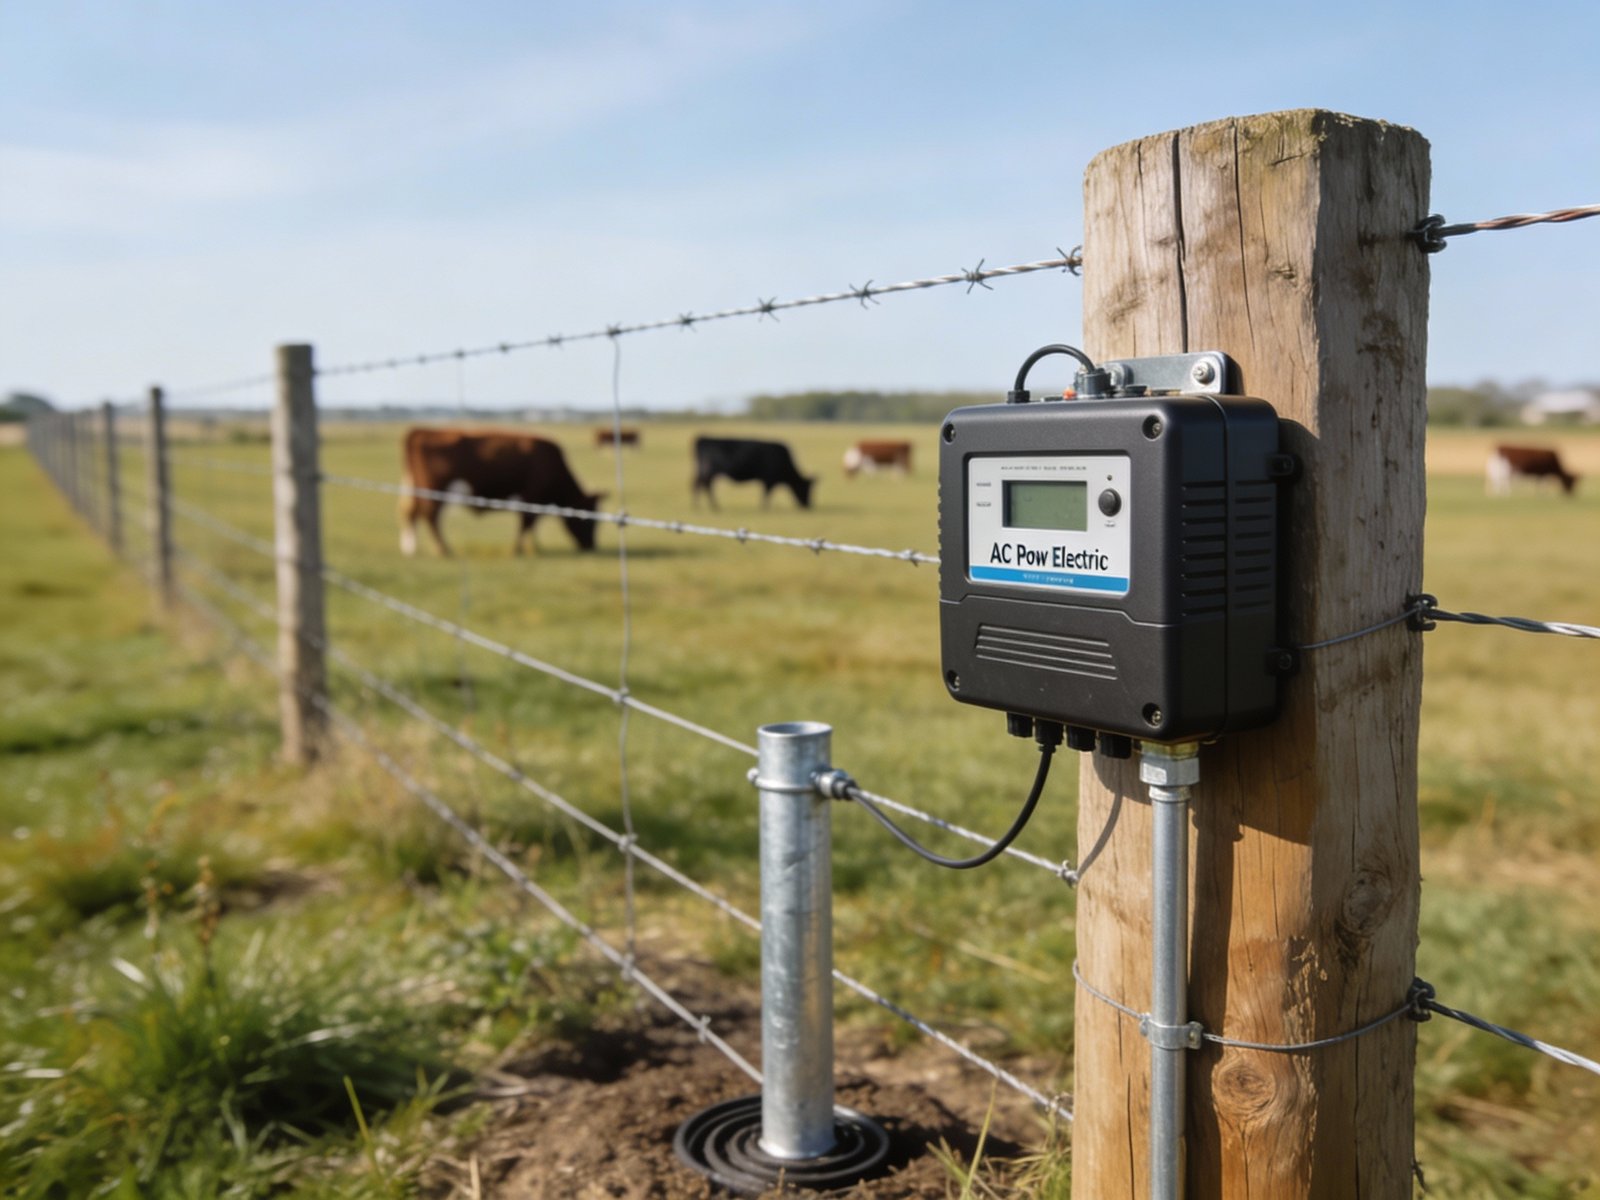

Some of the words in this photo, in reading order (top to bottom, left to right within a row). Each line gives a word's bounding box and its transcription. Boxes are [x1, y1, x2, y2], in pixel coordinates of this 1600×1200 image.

[990, 542, 1012, 563] AC
[1017, 544, 1048, 566] Pow
[1053, 546, 1108, 570] Electric
